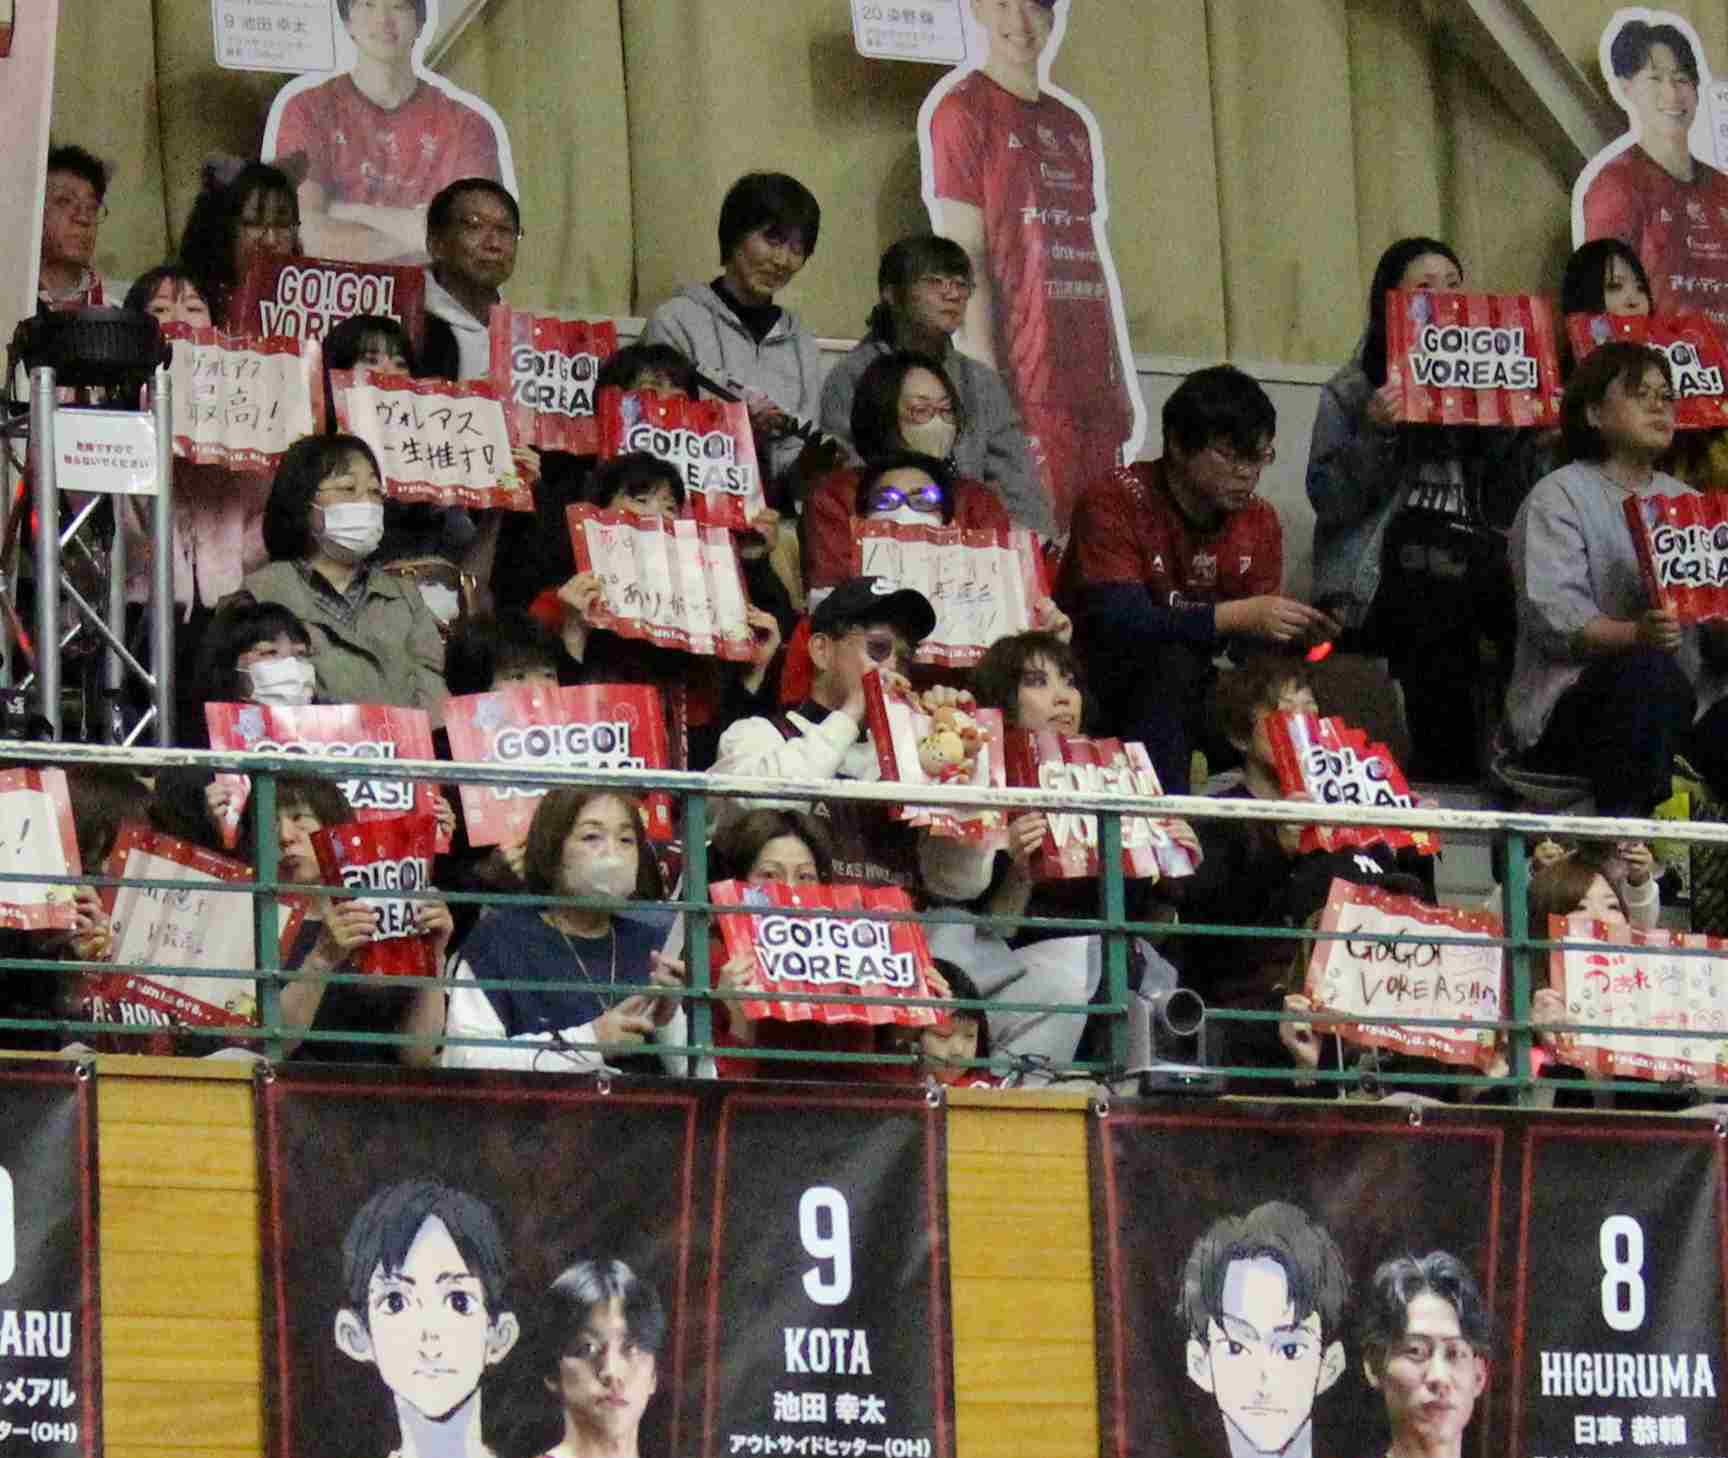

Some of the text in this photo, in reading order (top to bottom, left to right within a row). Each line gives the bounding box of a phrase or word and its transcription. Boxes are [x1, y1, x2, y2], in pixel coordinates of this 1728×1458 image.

[279, 269, 396, 317] GO!GO!
[1424, 326, 1521, 354] GO!GO!
[1413, 360, 1536, 388] VOREAS!
[629, 426, 735, 461] GO!GO!
[497, 726, 626, 759] GO!GO!
[762, 922, 891, 952] GO!GO!
[797, 1186, 853, 1306] 9
[1599, 1215, 1646, 1331] 8
[783, 1328, 873, 1377] KOTA
[1539, 1352, 1716, 1399] HIGURUMA
[772, 1392, 886, 1424] 池田 幸太
[729, 1435, 932, 1458] アウトサイドヒッター(OH)
[1574, 1415, 1622, 1445] 日車
